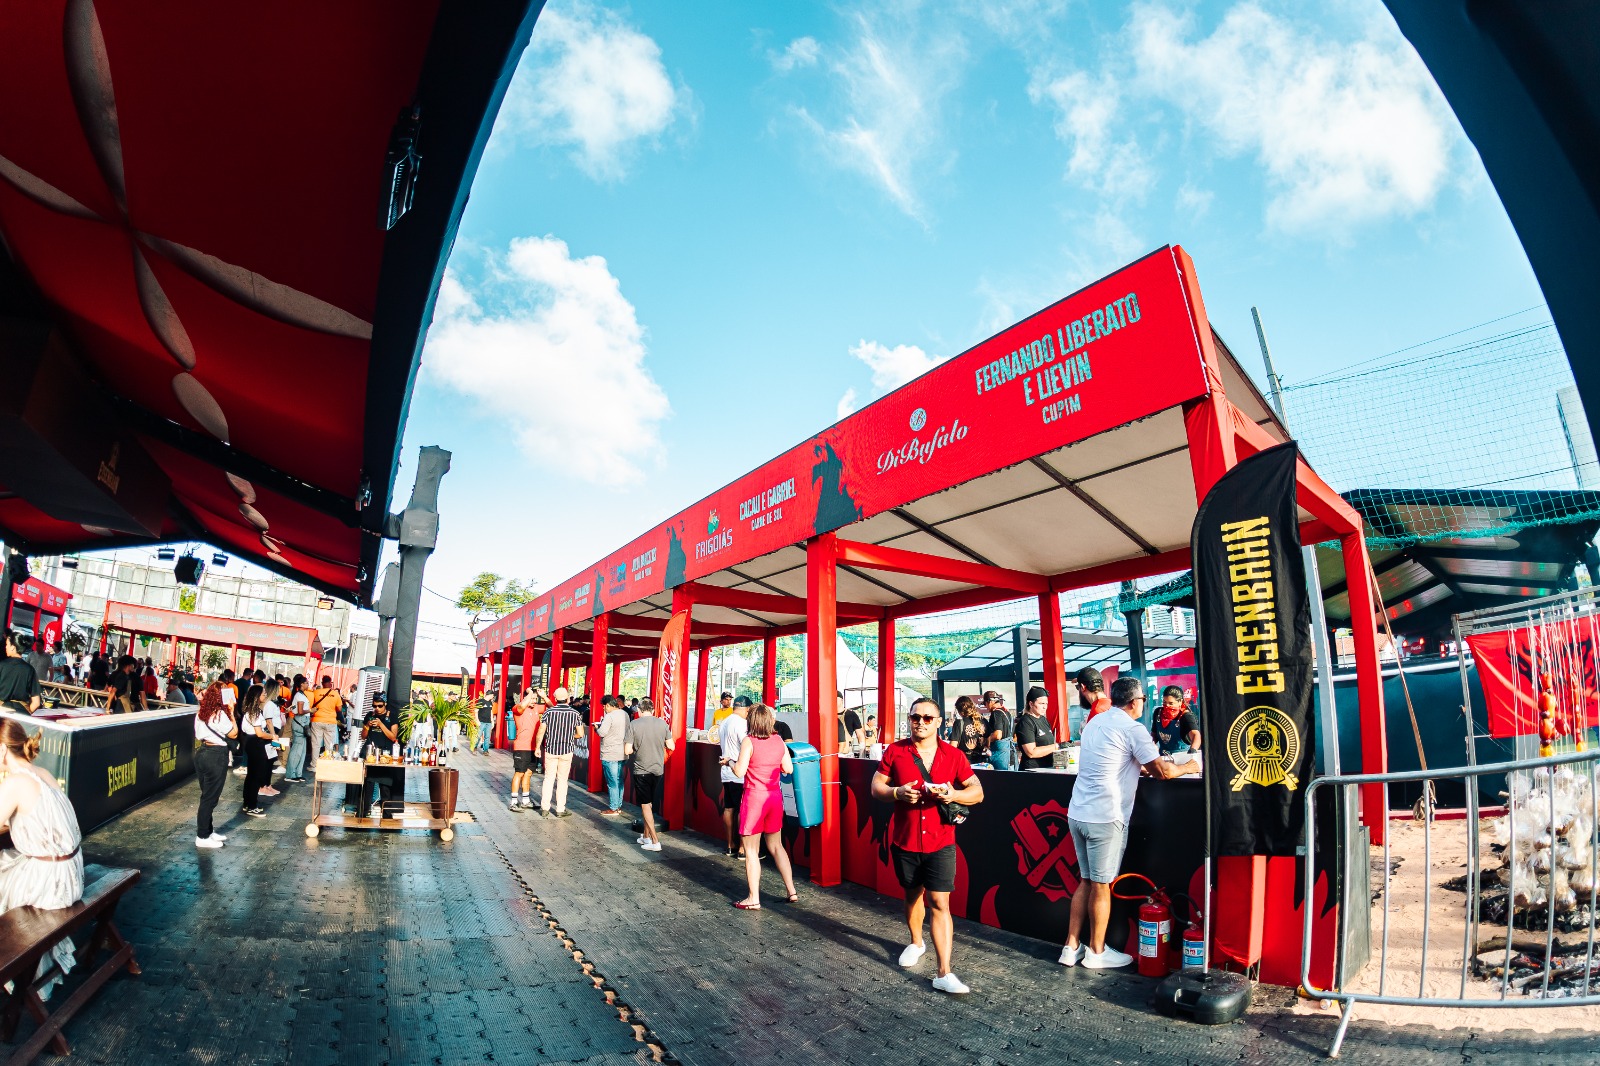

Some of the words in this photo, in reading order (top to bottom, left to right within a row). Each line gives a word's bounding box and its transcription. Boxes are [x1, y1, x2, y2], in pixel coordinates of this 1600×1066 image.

[975, 334, 1056, 395] FERNANDO
[1057, 292, 1142, 356] LIBERATO
[1023, 376, 1035, 406] E
[1036, 351, 1093, 401] LIEVIN
[1042, 393, 1083, 424] CUPIM
[876, 418, 970, 475] DiBufalo
[739, 494, 761, 521] CACAU
[761, 491, 766, 511] E
[767, 477, 797, 508] GABRIEL
[751, 515, 766, 531] CARNE
[766, 511, 773, 525] DE
[773, 507, 783, 521] SOL
[695, 527, 733, 560] FRIGOIÁS
[1220, 515, 1286, 696] EISENBAHN
